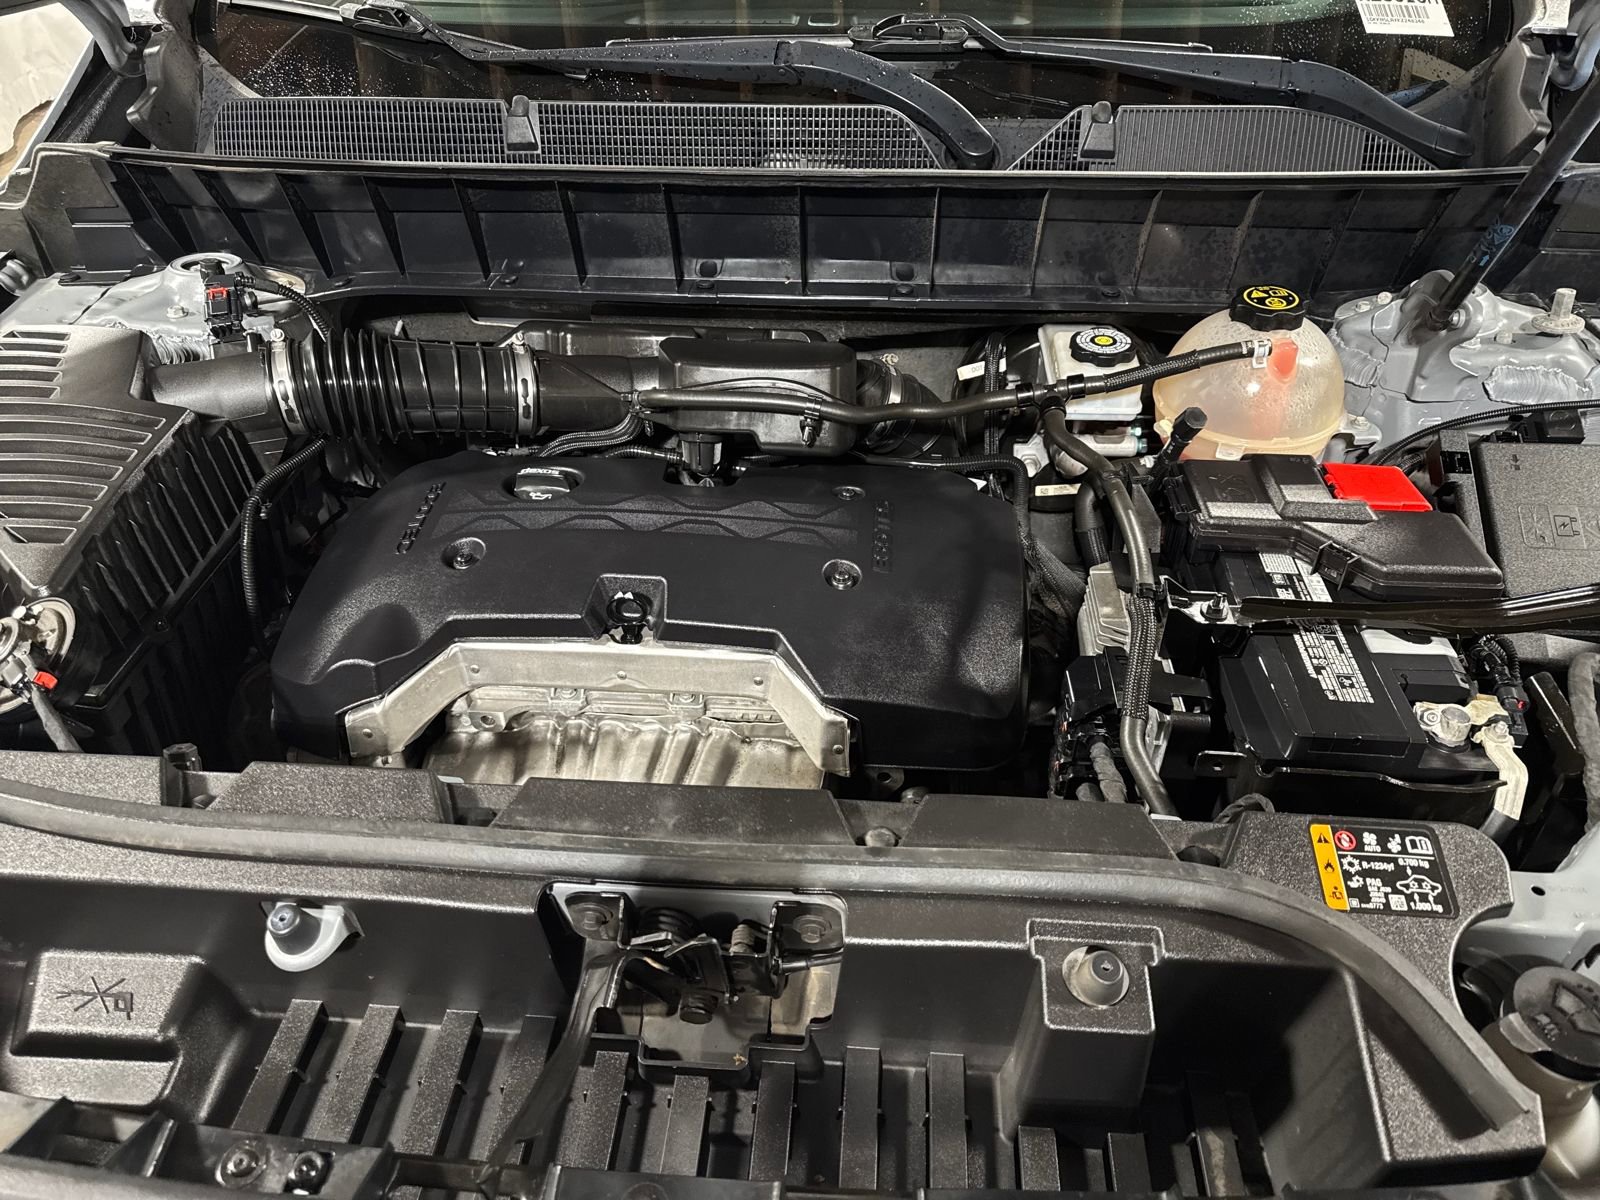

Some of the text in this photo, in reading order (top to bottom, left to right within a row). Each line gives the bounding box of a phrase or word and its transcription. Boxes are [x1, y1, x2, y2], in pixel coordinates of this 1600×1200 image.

[1361, 861, 1394, 872] R-1234yf
[1418, 859, 1430, 869] kg
[1365, 878, 1382, 887] PAG
[1432, 904, 1443, 913] kg
